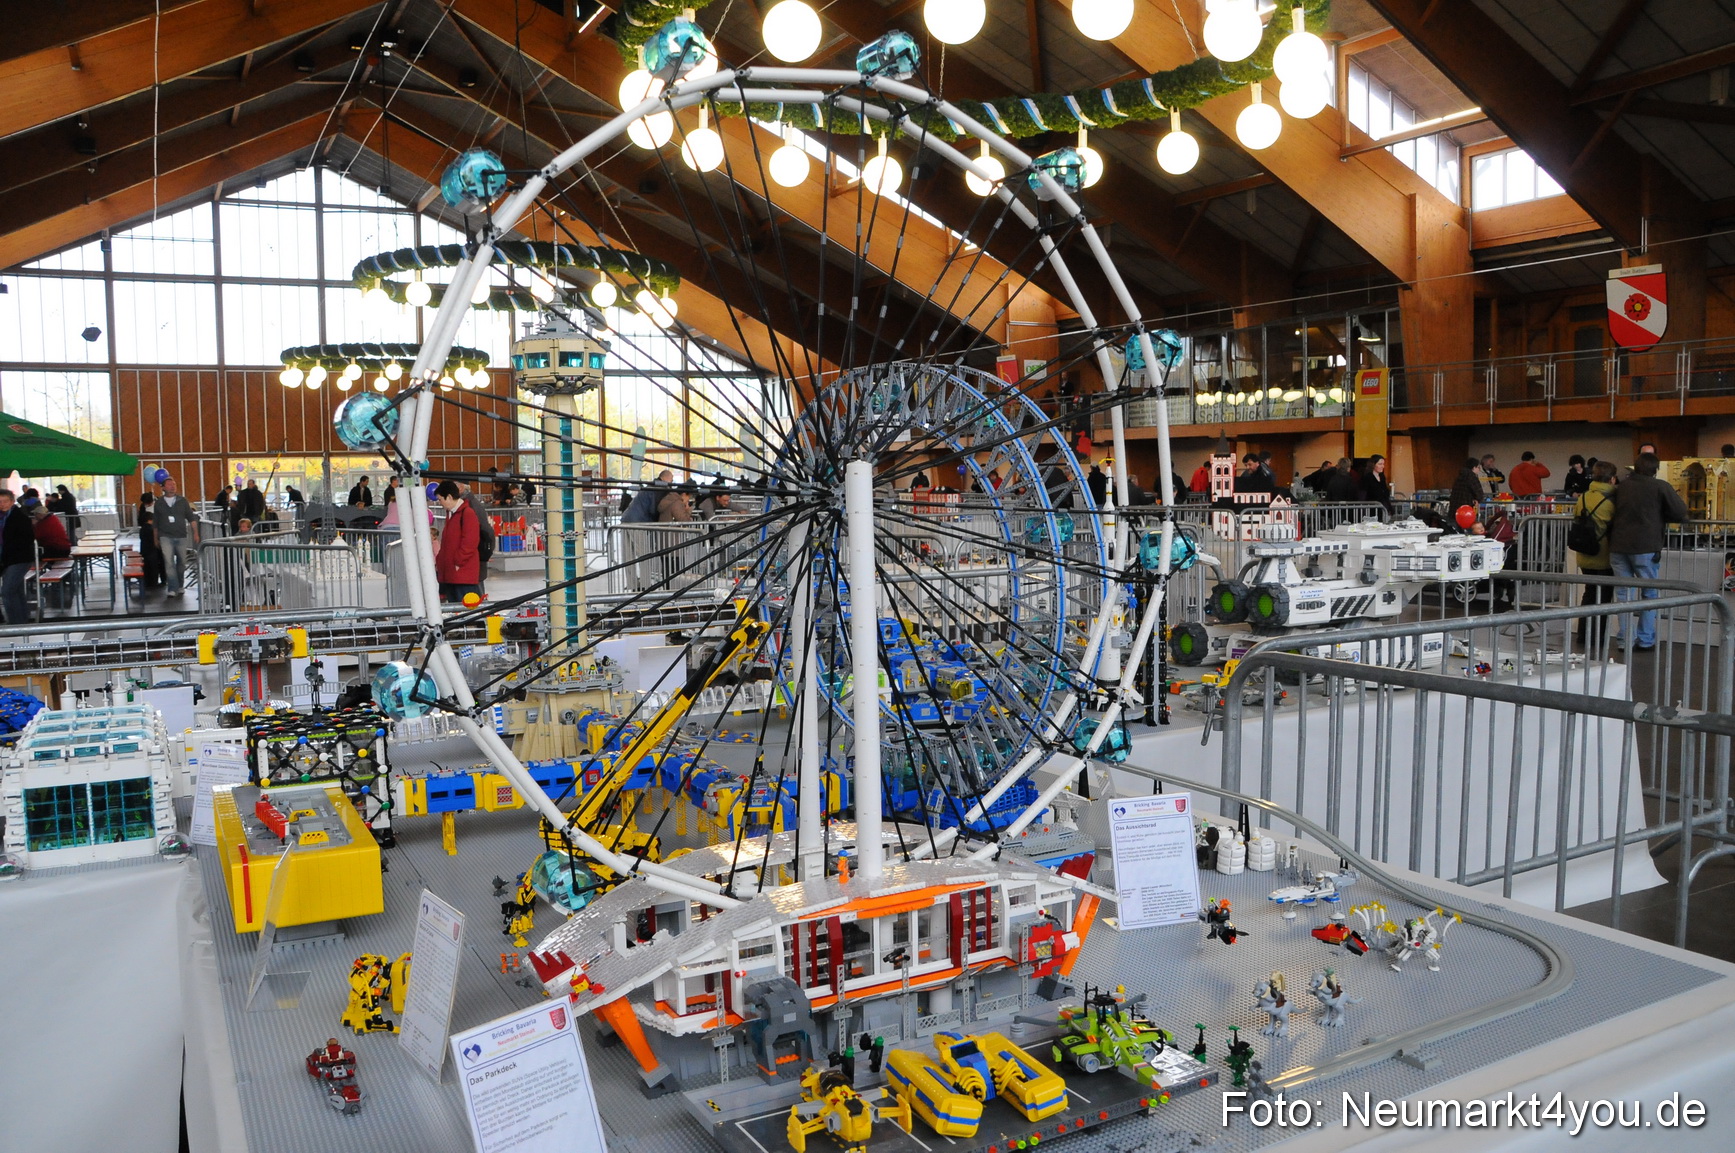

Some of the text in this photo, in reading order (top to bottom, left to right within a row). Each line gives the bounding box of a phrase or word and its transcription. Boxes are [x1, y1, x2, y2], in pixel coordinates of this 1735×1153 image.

[1363, 378, 1379, 387] LEGO
[1126, 822, 1157, 830] Aussichtsrad
[491, 1019, 536, 1040] Bricking Bavaria
[469, 1062, 517, 1086] Das Parkdeck
